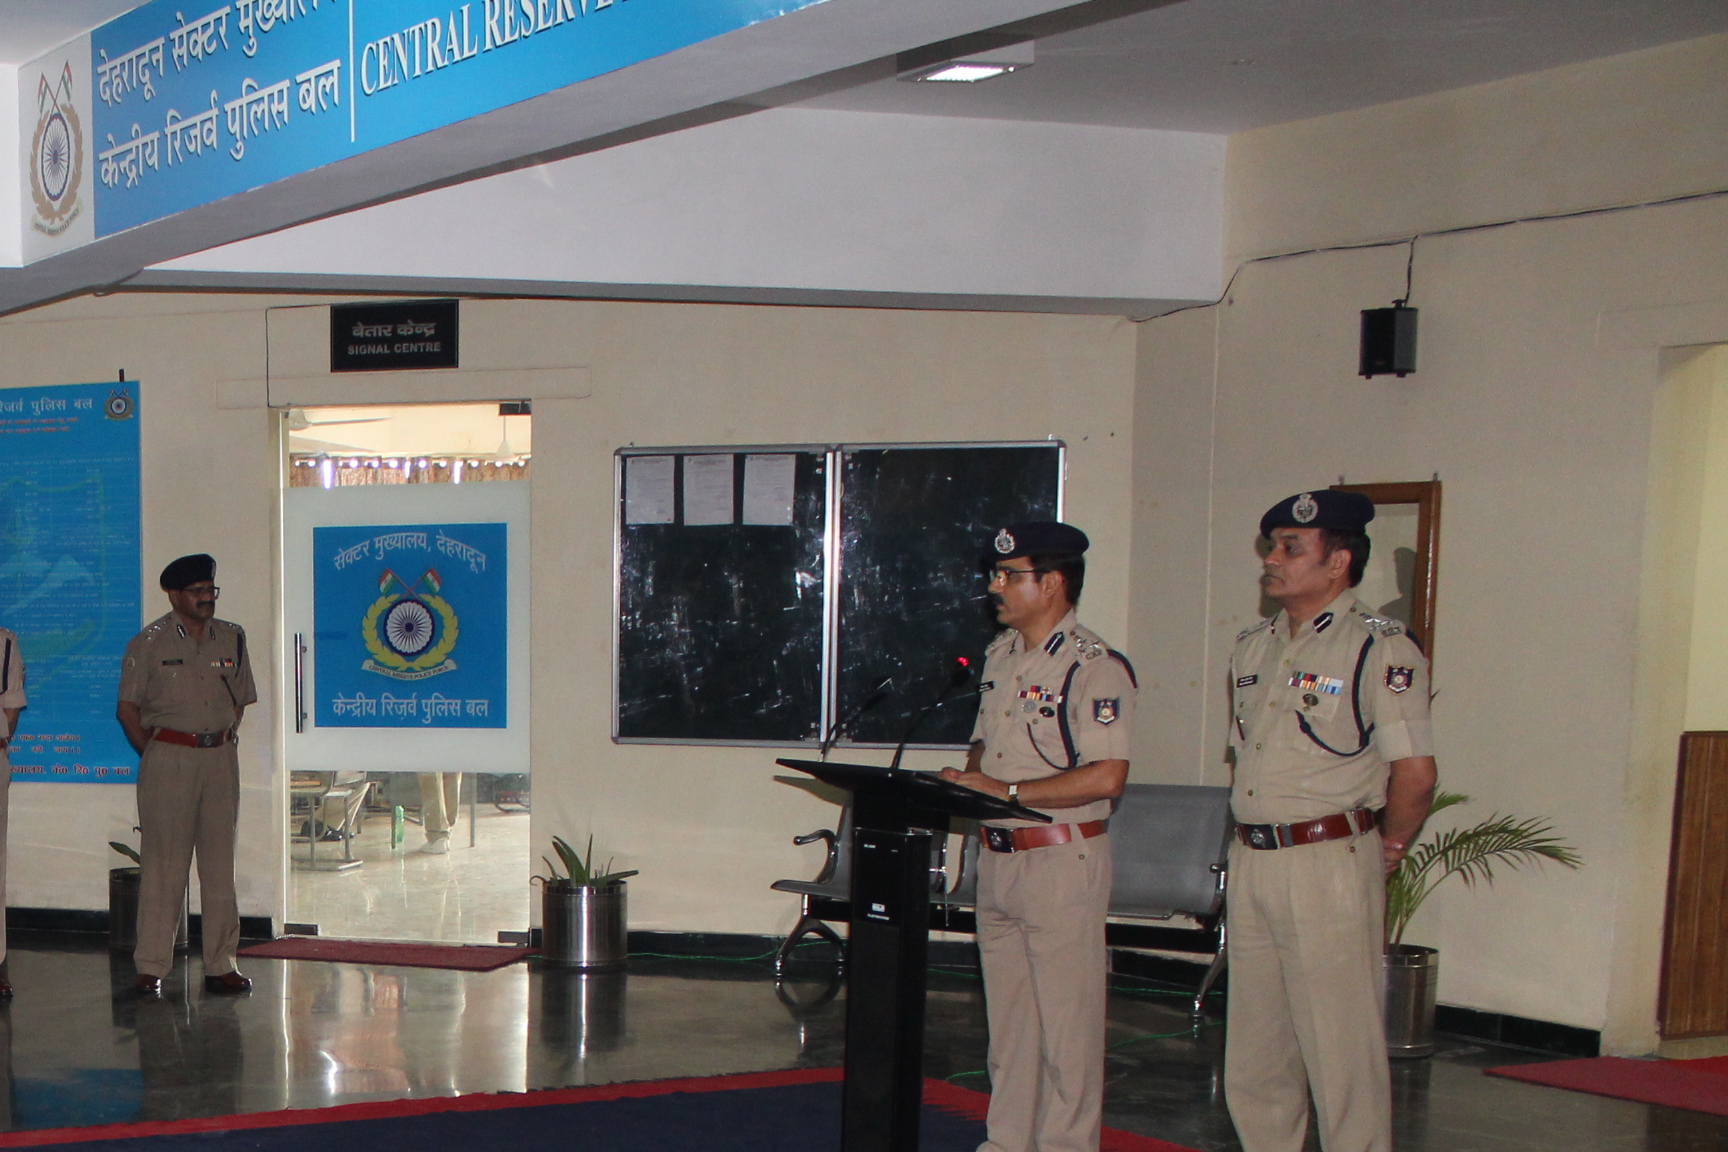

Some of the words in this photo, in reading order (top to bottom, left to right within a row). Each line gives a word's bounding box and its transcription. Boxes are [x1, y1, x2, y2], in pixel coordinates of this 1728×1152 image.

[97, 49, 165, 107] देहरादून
[169, 6, 232, 72] सेक्टर
[360, 3, 478, 96] CENTRAL
[98, 123, 160, 189] केन्द्रीय
[165, 89, 219, 166] रिजर्व
[224, 77, 290, 161] पुलिस
[295, 59, 342, 115] बल
[347, 343, 390, 355] SIGNAL
[394, 341, 441, 354] CENTRE
[334, 540, 370, 570] सेक्टर
[436, 529, 486, 573] देहरादून
[332, 692, 376, 717] केन्द्रीय
[421, 692, 461, 724] पुलिस
[466, 699, 489, 717] बल
